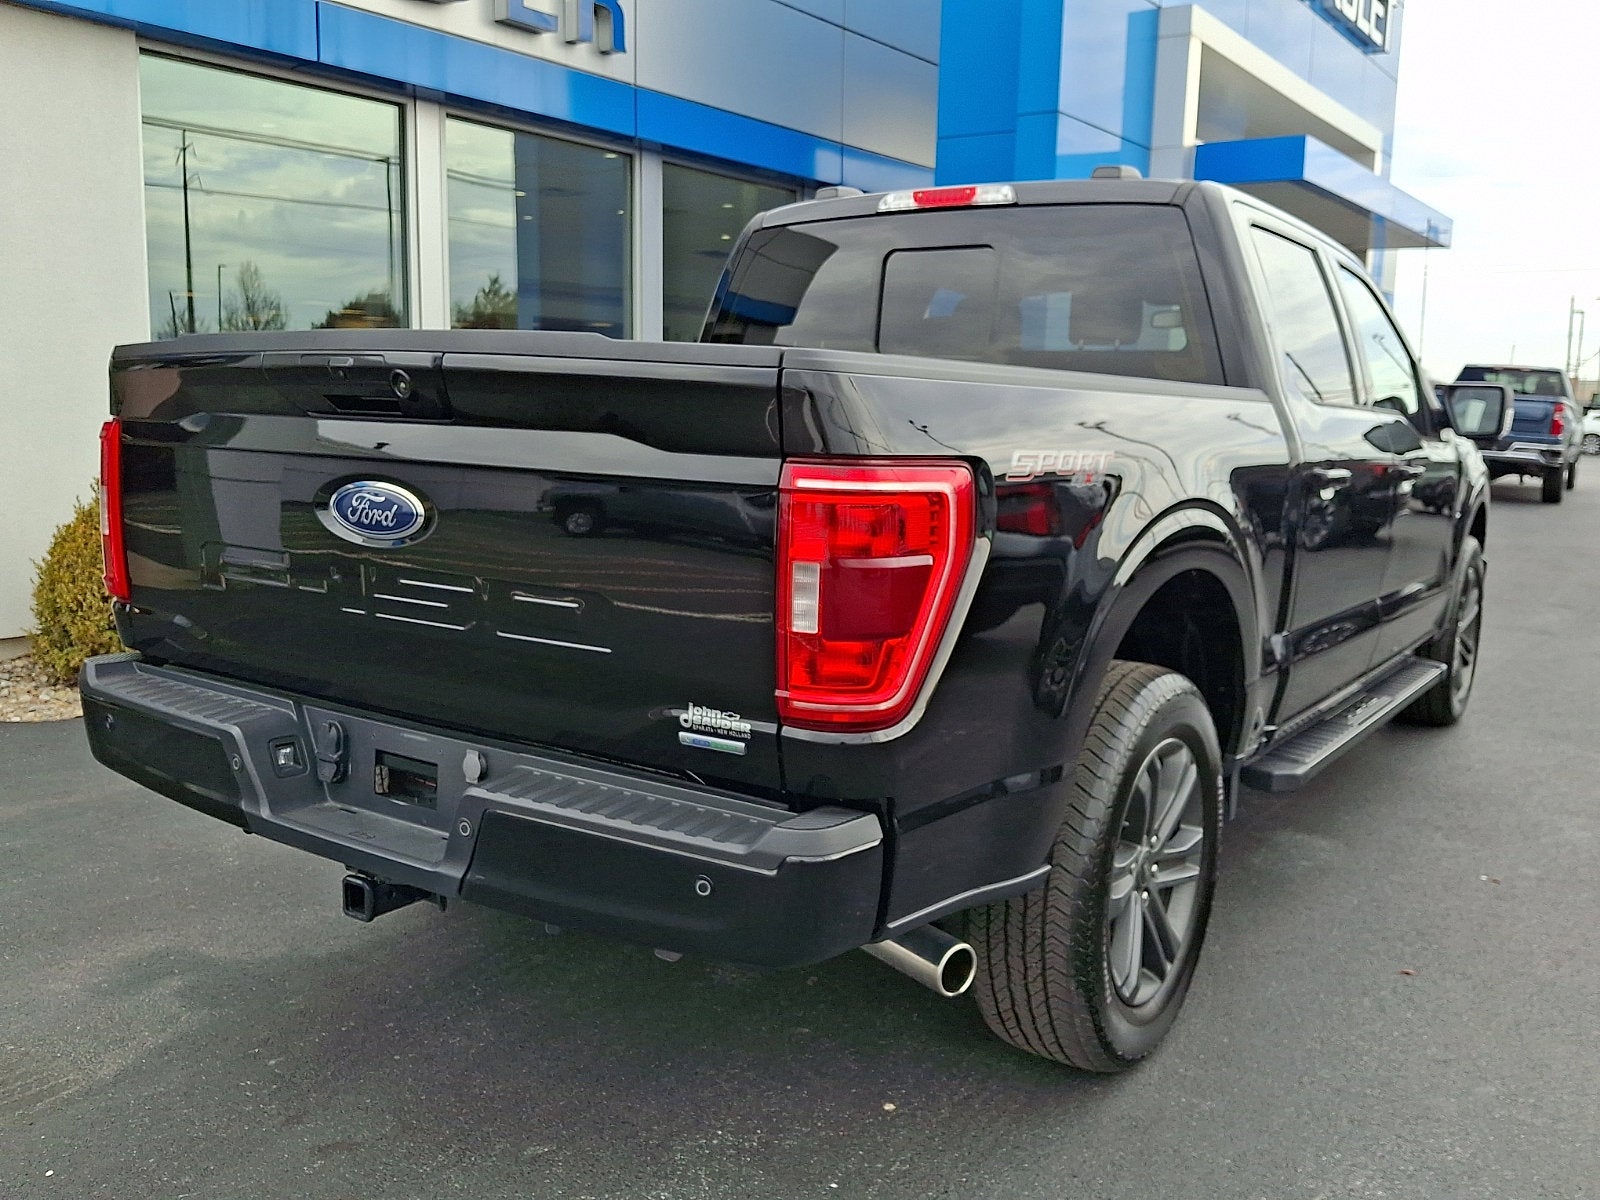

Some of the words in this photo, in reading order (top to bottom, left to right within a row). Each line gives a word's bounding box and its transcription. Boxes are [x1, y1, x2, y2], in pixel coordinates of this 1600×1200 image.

[1006, 450, 1115, 482] SPORT
[347, 492, 399, 528] Ford
[693, 715, 752, 733] SAUDER
